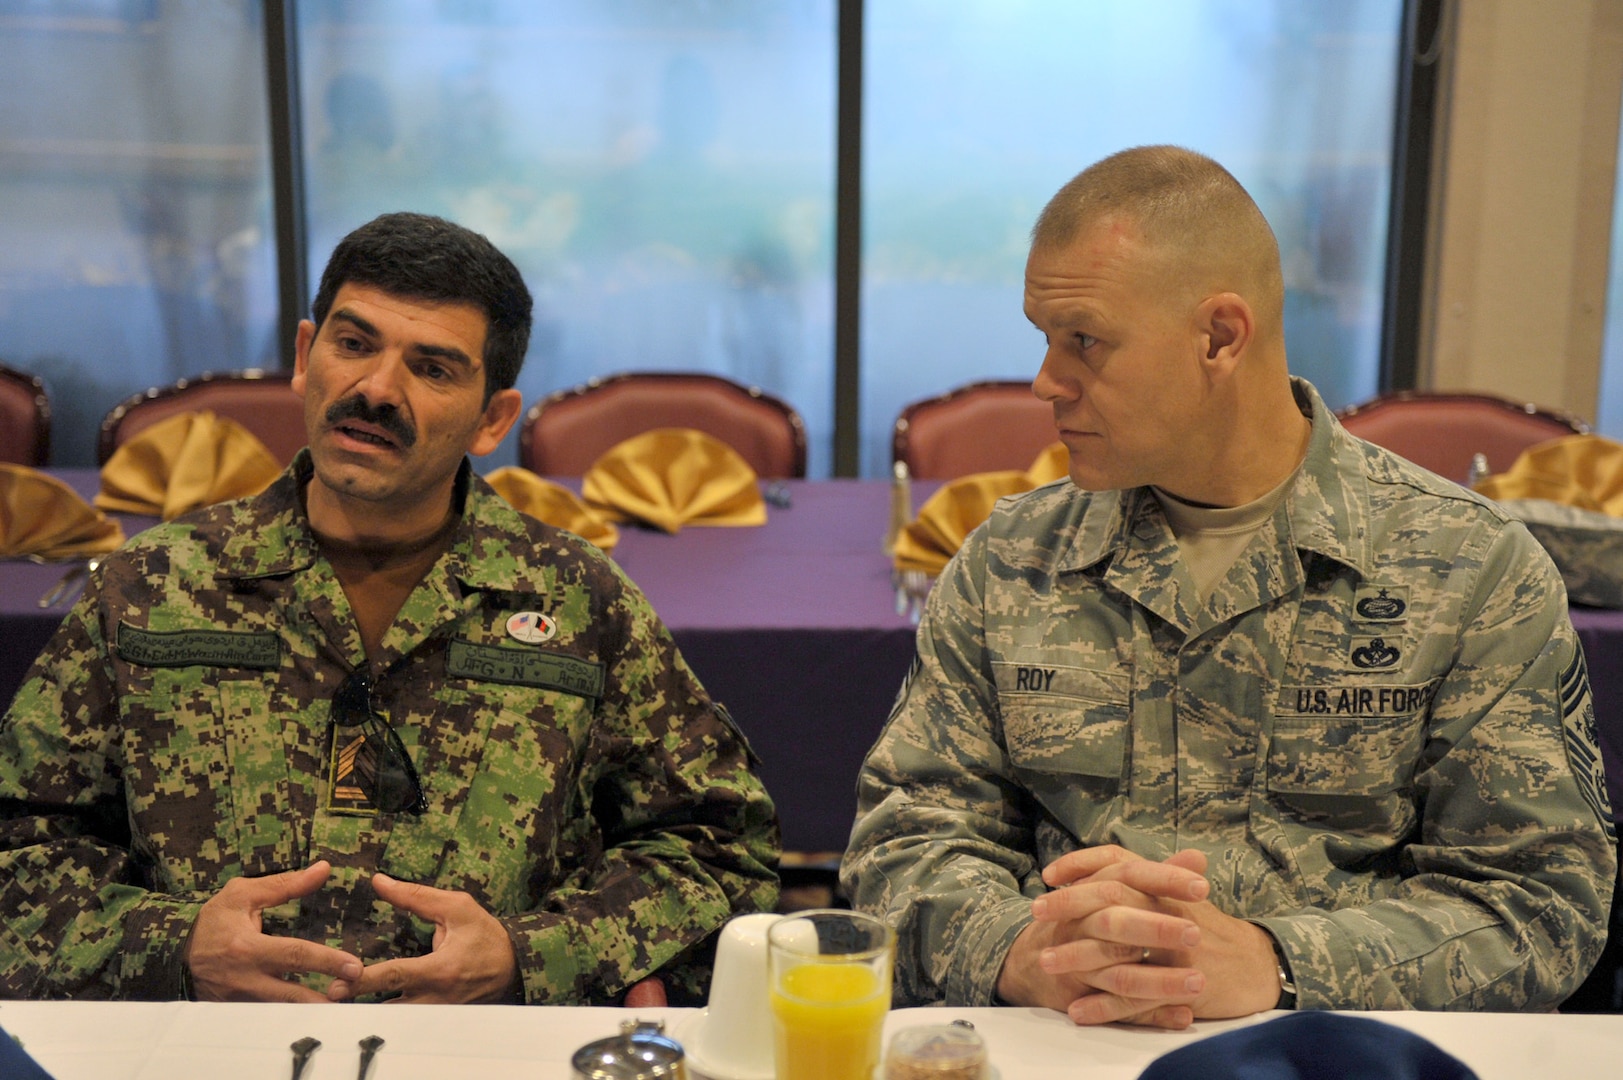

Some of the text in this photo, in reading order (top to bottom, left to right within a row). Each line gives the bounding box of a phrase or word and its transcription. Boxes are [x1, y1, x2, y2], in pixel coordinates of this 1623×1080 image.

[1016, 667, 1056, 692] ROY
[1296, 686, 1431, 714] U.S. AIR FORC
